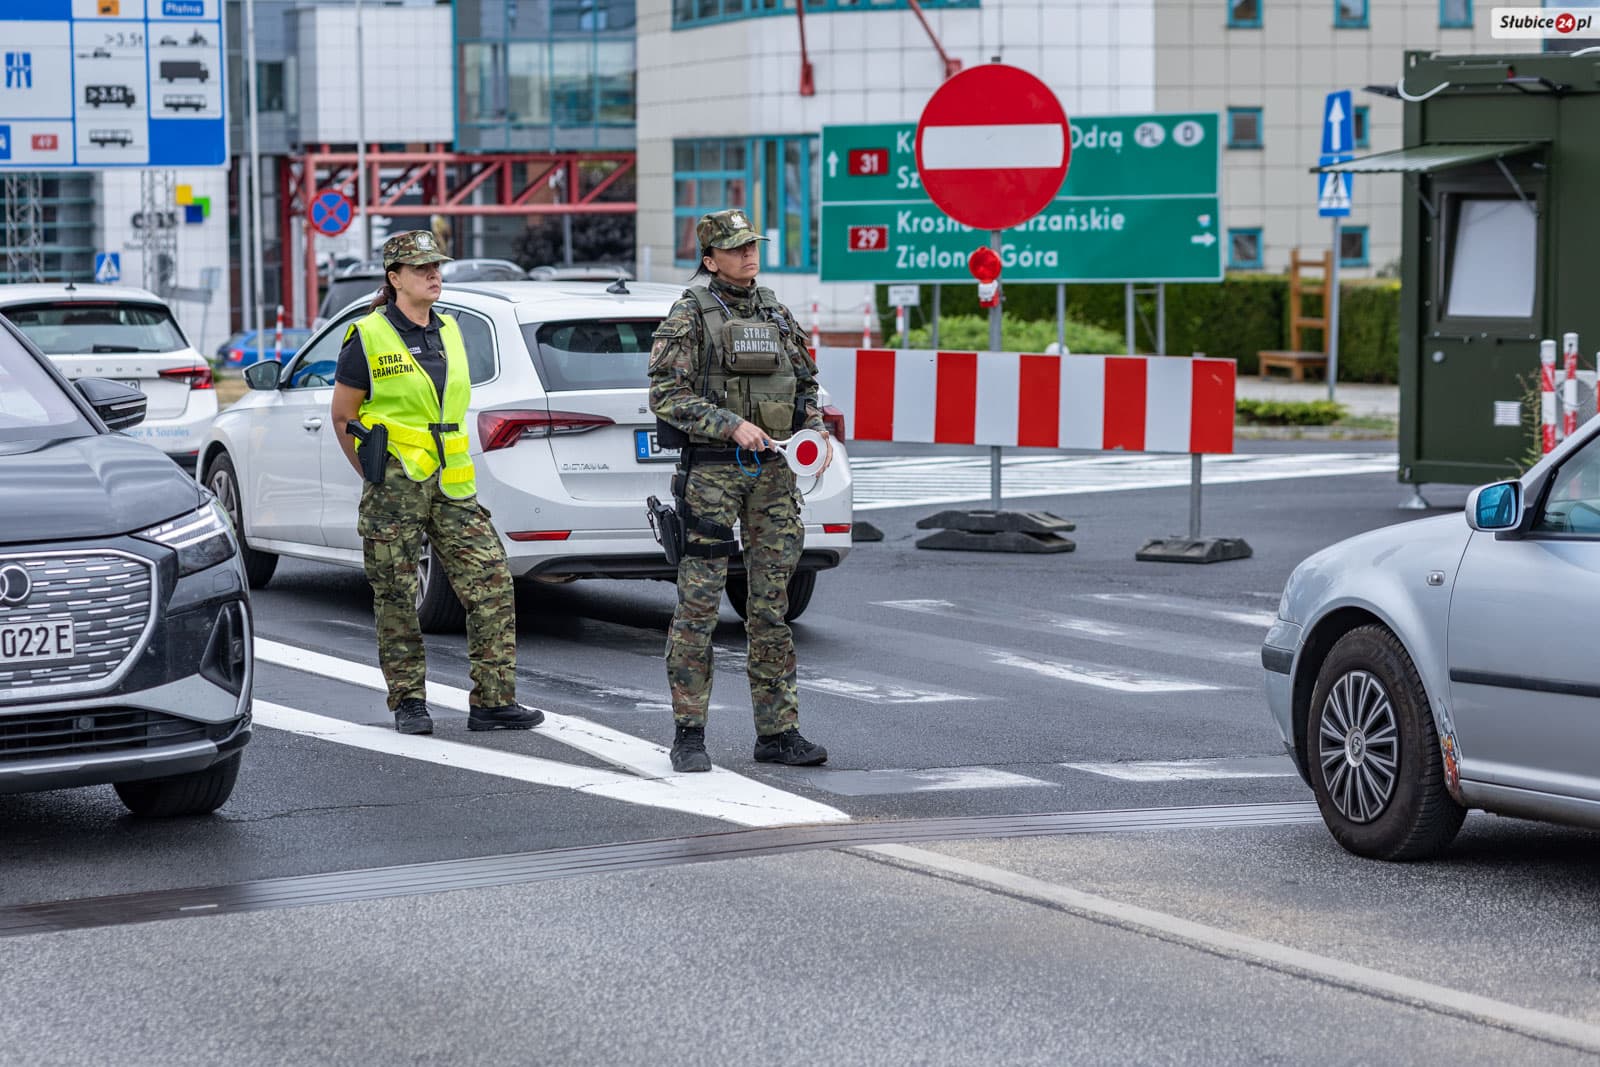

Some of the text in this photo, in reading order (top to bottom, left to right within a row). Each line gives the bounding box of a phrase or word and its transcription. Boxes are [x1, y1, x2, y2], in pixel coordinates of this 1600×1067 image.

[1140, 125, 1160, 145] PL
[1182, 124, 1196, 143] D
[860, 152, 879, 174] 31
[857, 228, 880, 249] 29
[896, 243, 1059, 269] Zielon Góra
[372, 363, 414, 379] GRANICZNA
